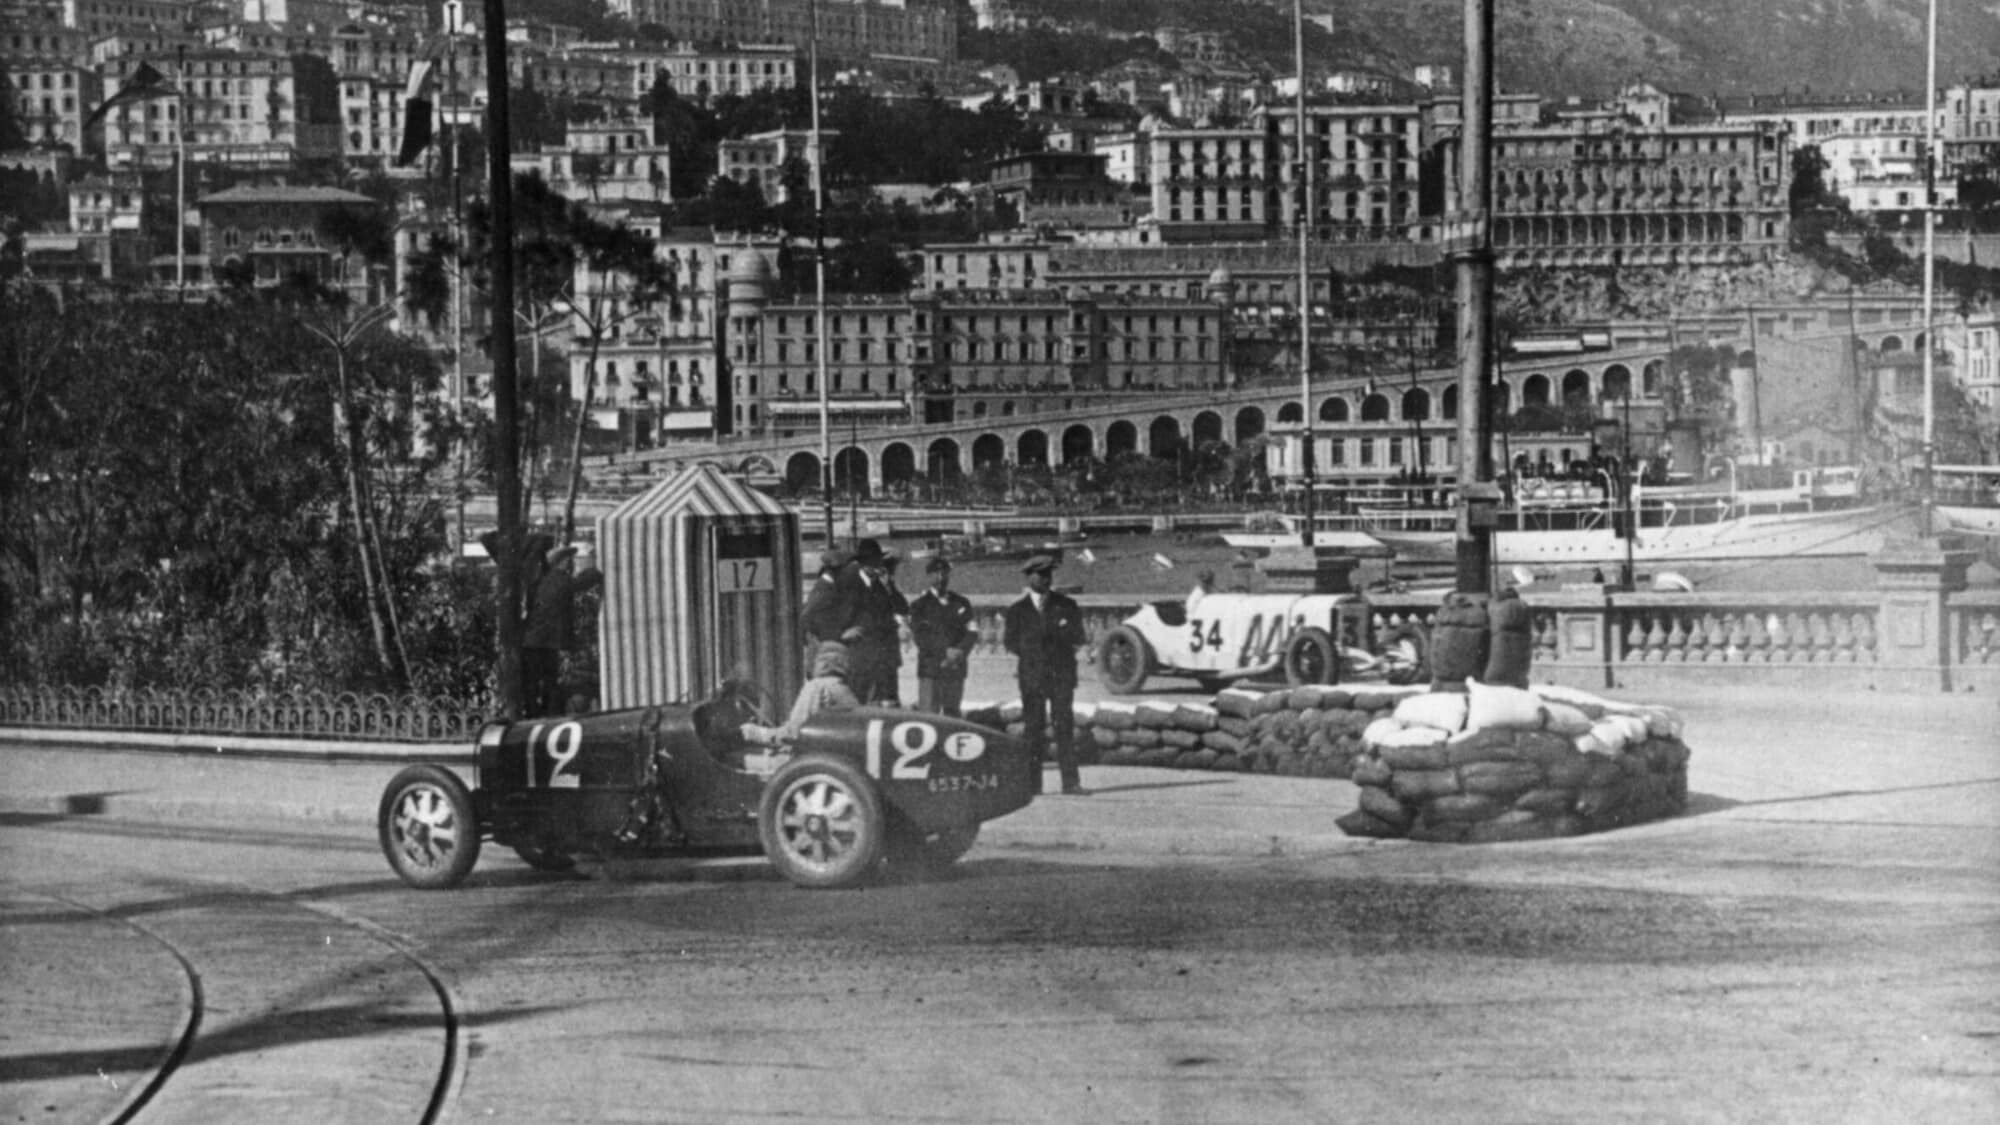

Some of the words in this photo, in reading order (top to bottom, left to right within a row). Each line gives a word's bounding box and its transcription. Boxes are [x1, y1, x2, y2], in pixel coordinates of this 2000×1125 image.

[732, 561, 758, 589] 17
[1189, 619, 1224, 653] 34
[526, 721, 583, 788] 12
[866, 719, 938, 779] 12
[956, 735, 972, 757] F
